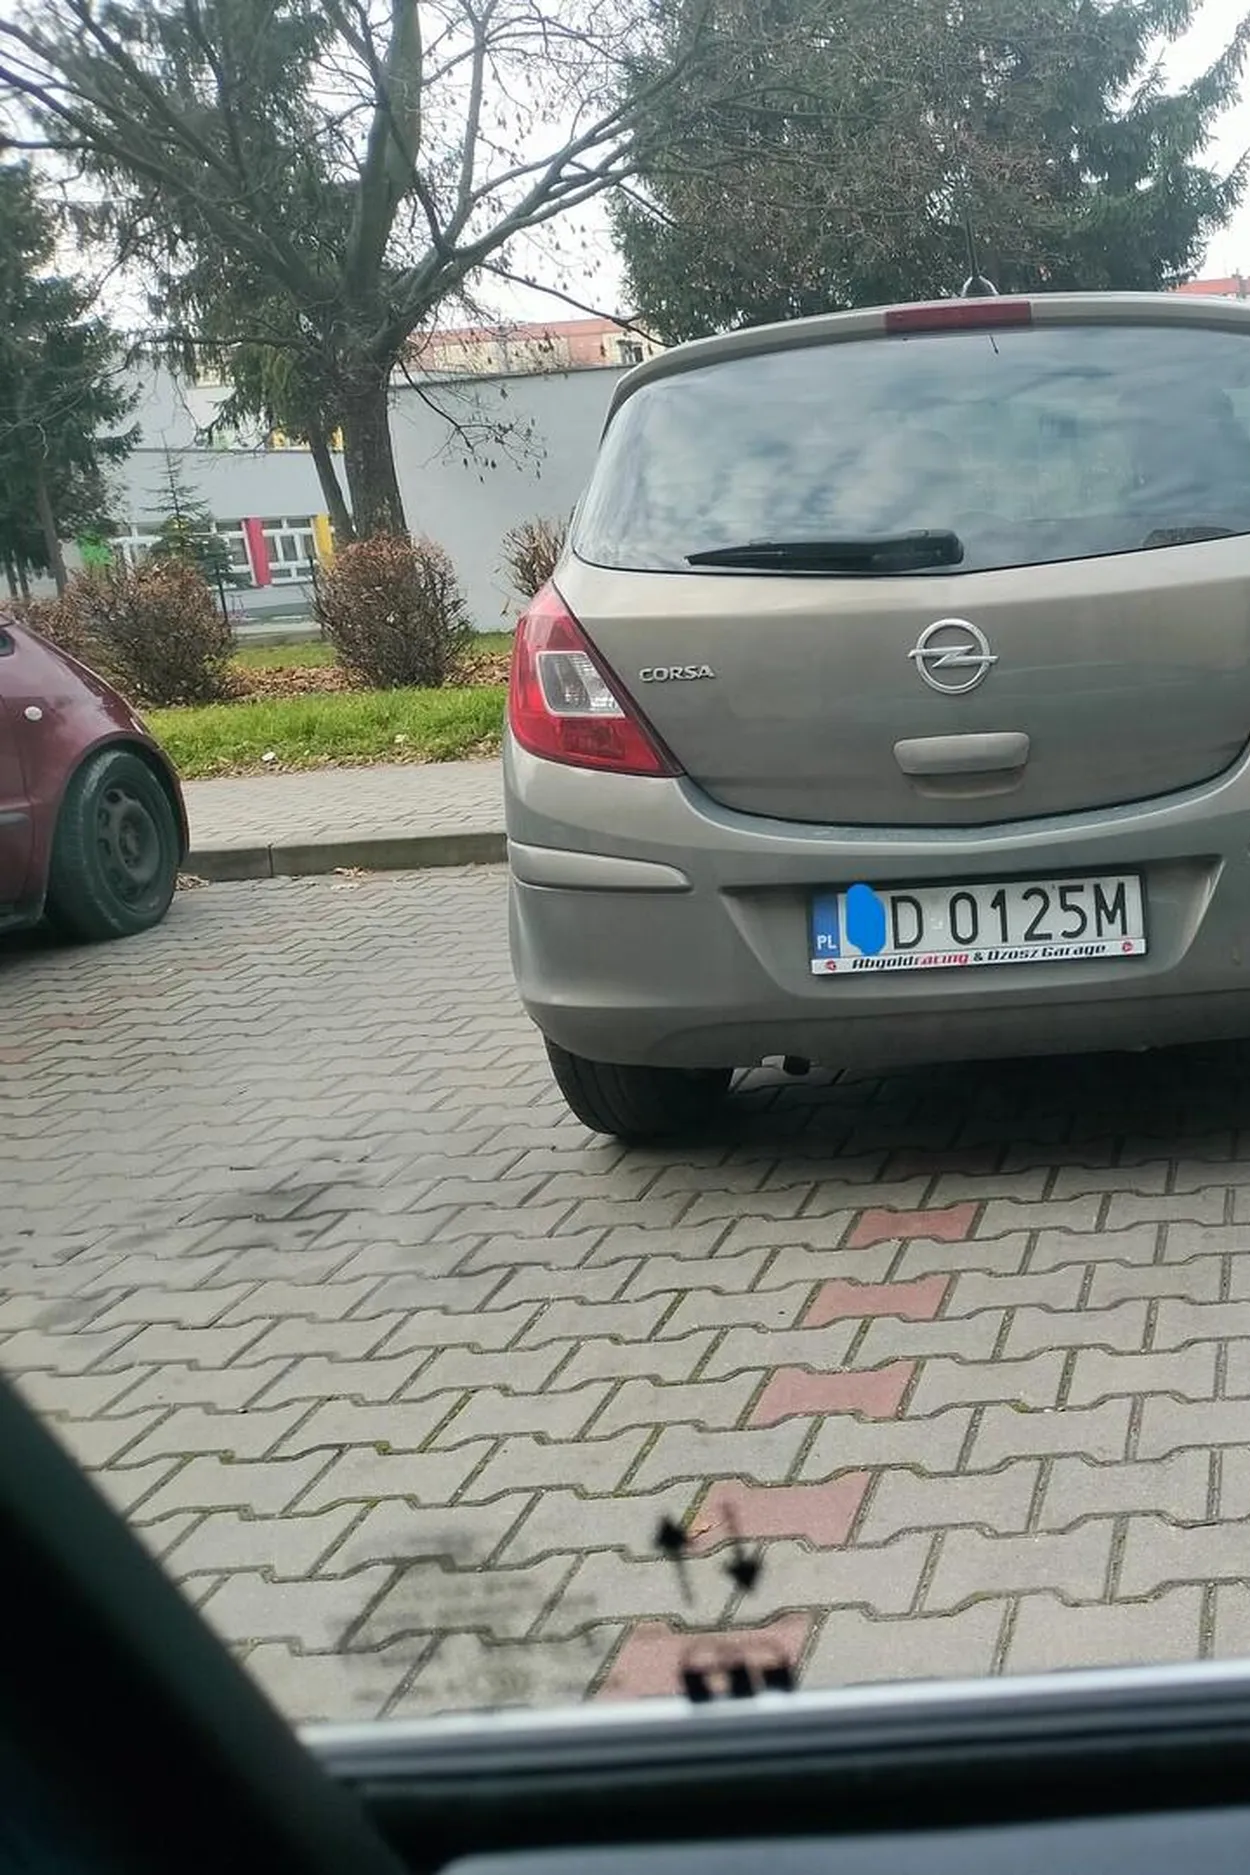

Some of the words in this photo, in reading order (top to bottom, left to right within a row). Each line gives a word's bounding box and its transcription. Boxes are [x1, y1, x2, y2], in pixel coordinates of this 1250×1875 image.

[639, 664, 716, 683] CORSA
[949, 881, 1129, 946] 0125M
[816, 934, 838, 950] PL
[973, 951, 984, 962] &
